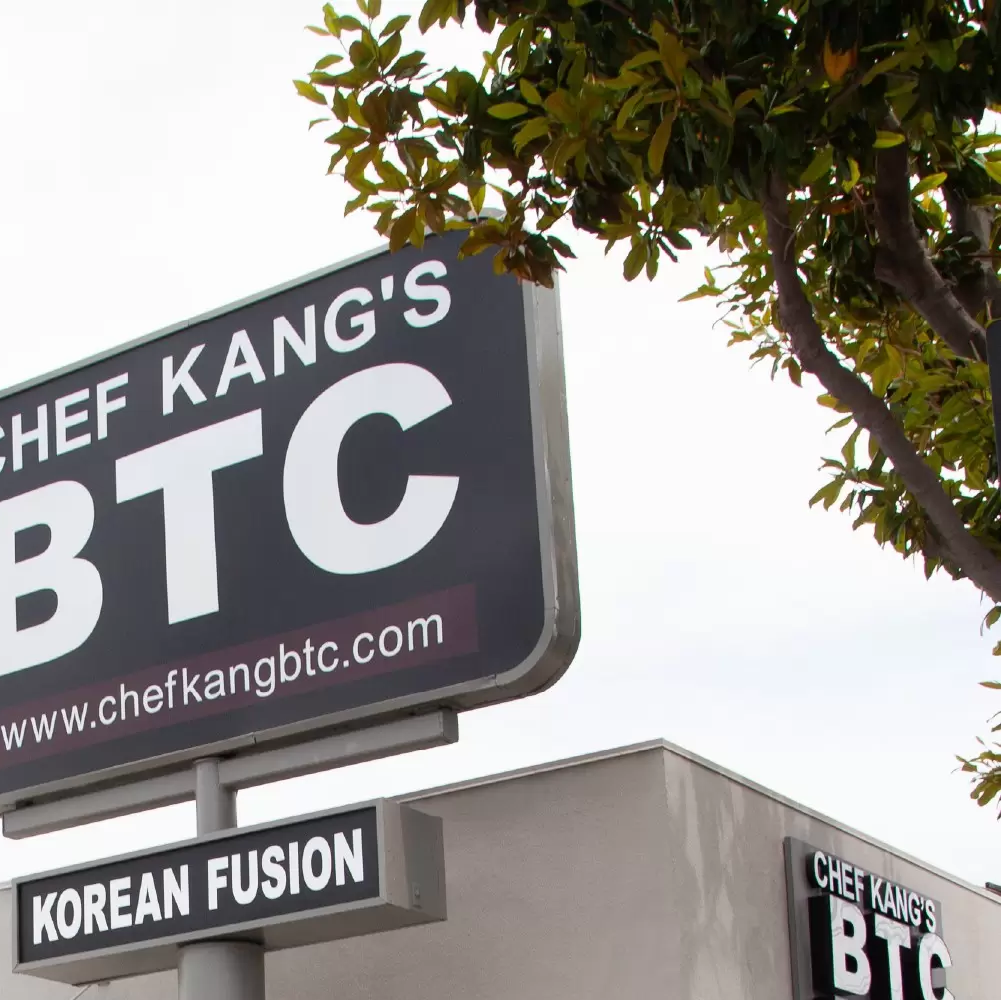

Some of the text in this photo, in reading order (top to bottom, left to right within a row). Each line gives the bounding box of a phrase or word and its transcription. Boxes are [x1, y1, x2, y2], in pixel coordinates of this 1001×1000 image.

[162, 260, 452, 415] KANG'S
[1, 611, 444, 751] www.chefkangbtc.com
[33, 828, 364, 945] KOREAN FUSION
[813, 850, 936, 934] CHEF KANG'S
